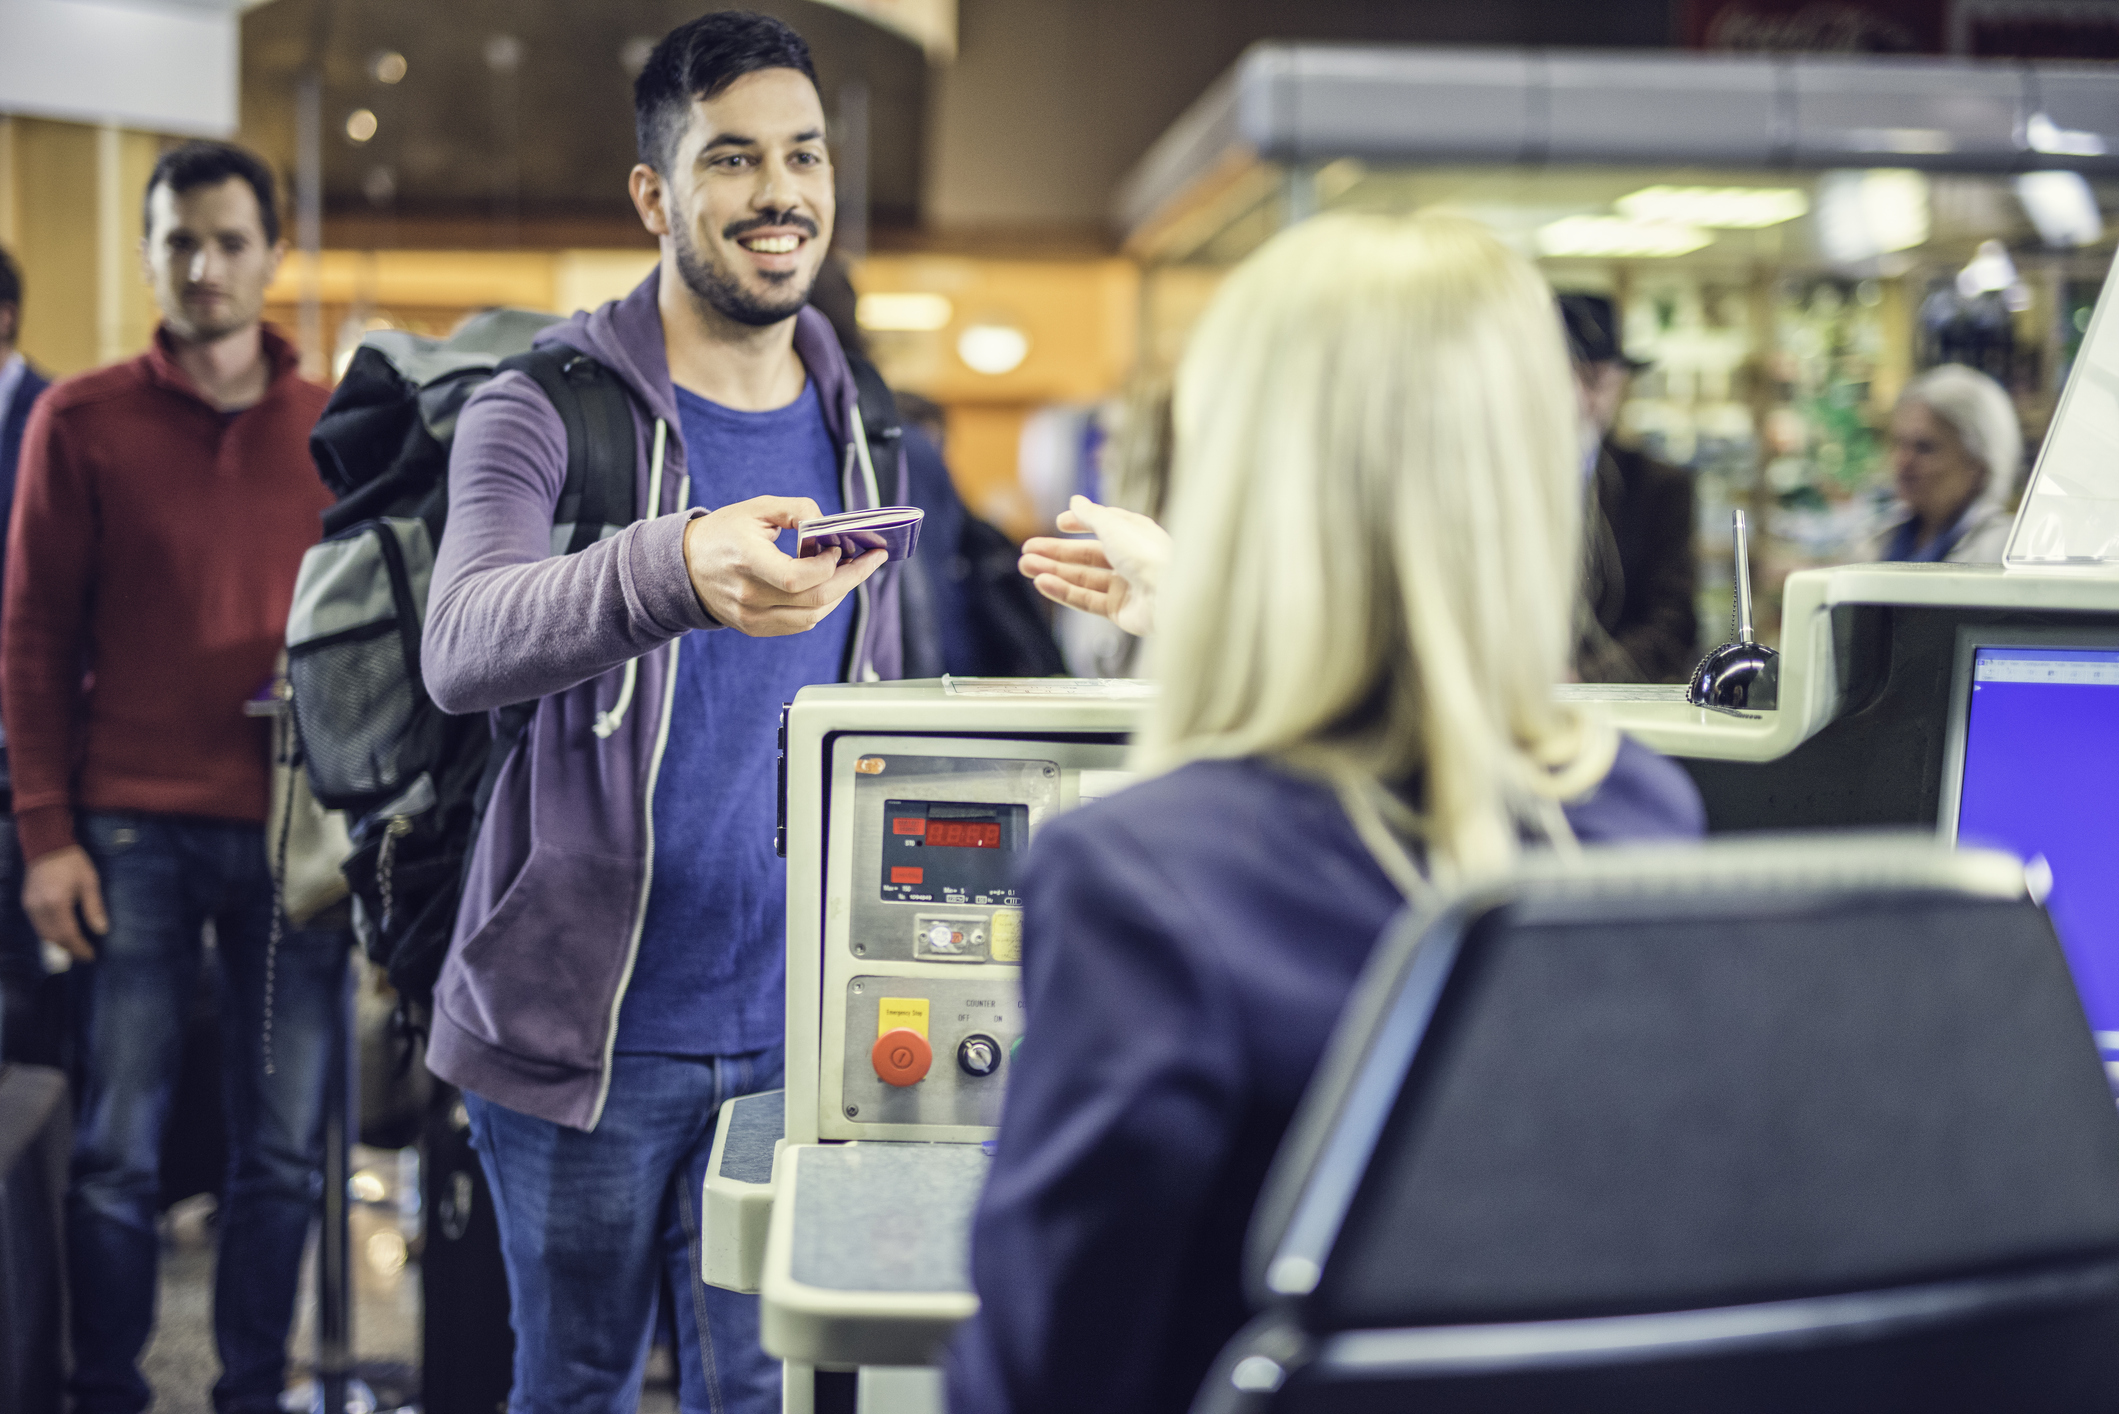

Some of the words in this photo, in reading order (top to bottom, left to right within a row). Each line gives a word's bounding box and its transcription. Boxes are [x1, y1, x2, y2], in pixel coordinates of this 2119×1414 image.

[966, 999, 996, 1008] COUNTER
[886, 1009, 911, 1017] Emergency
[912, 1009, 923, 1018] Stop
[958, 1014, 970, 1022] OFF
[994, 1015, 1003, 1023] ON
